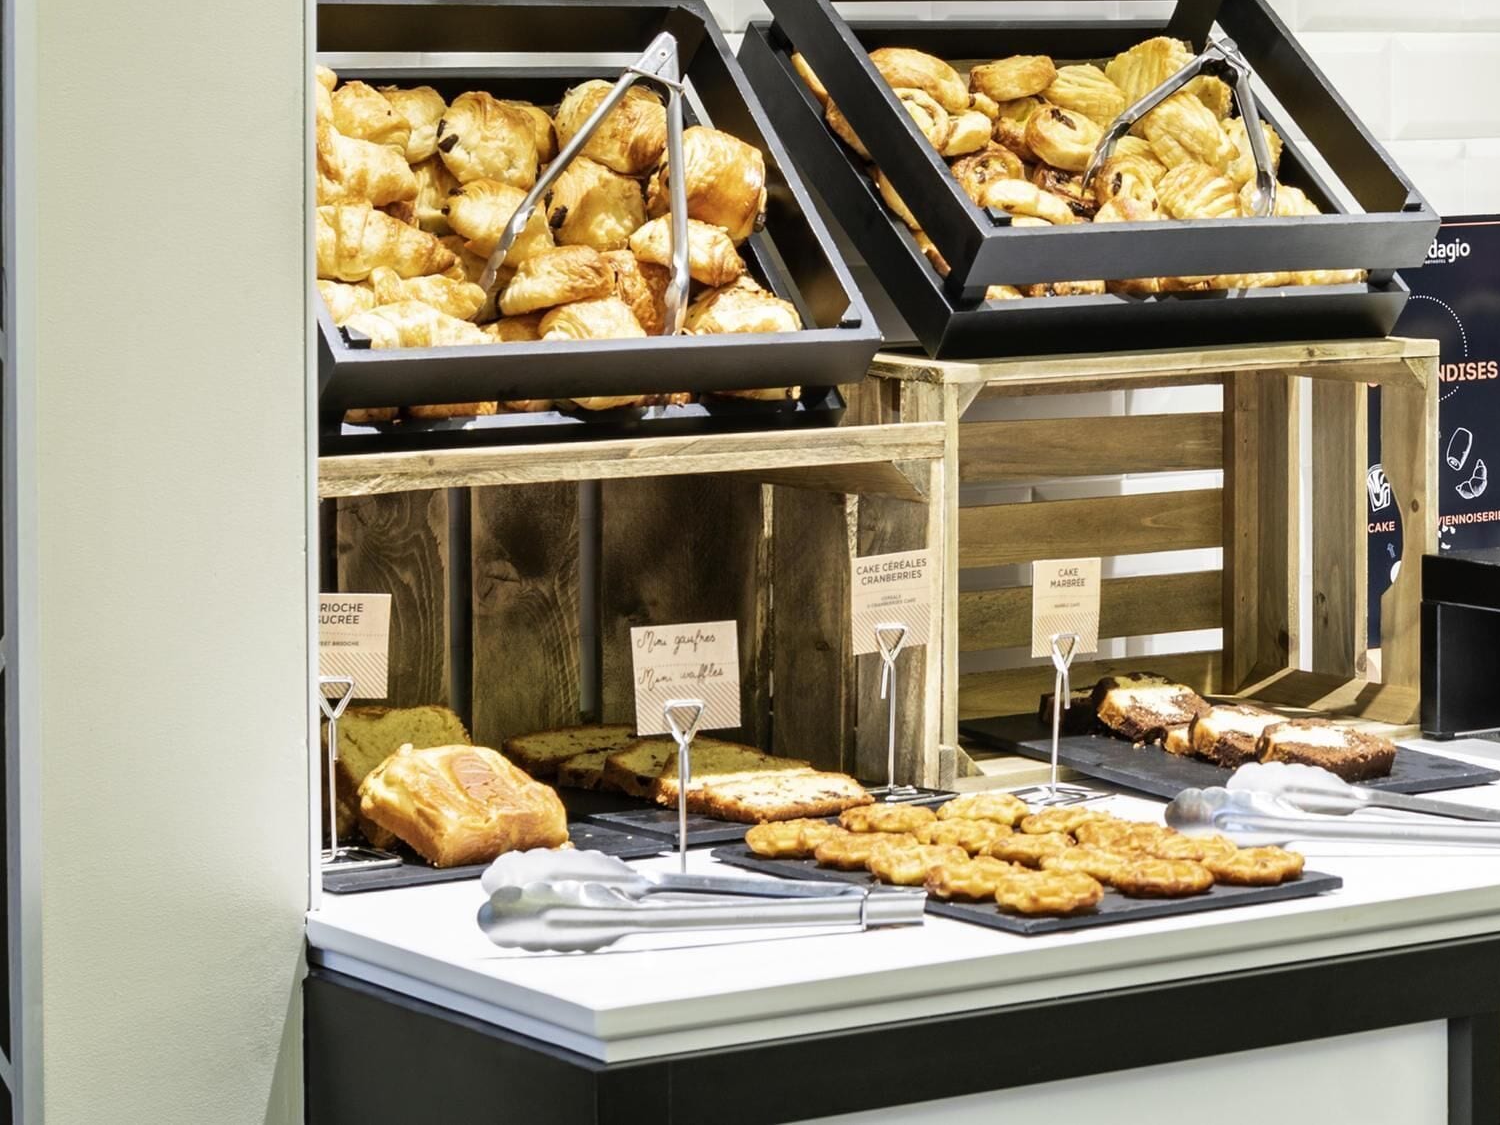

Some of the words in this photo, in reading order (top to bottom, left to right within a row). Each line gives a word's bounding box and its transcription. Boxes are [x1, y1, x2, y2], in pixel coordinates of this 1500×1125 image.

[1425, 238, 1470, 263] dagio
[1439, 361, 1499, 382] NDISES
[1367, 521, 1396, 533] CAKE
[856, 564, 880, 575] CAKE
[1058, 568, 1079, 577] CAKE
[861, 569, 922, 586] CRANBERRIES
[320, 603, 364, 612] RIOCHE
